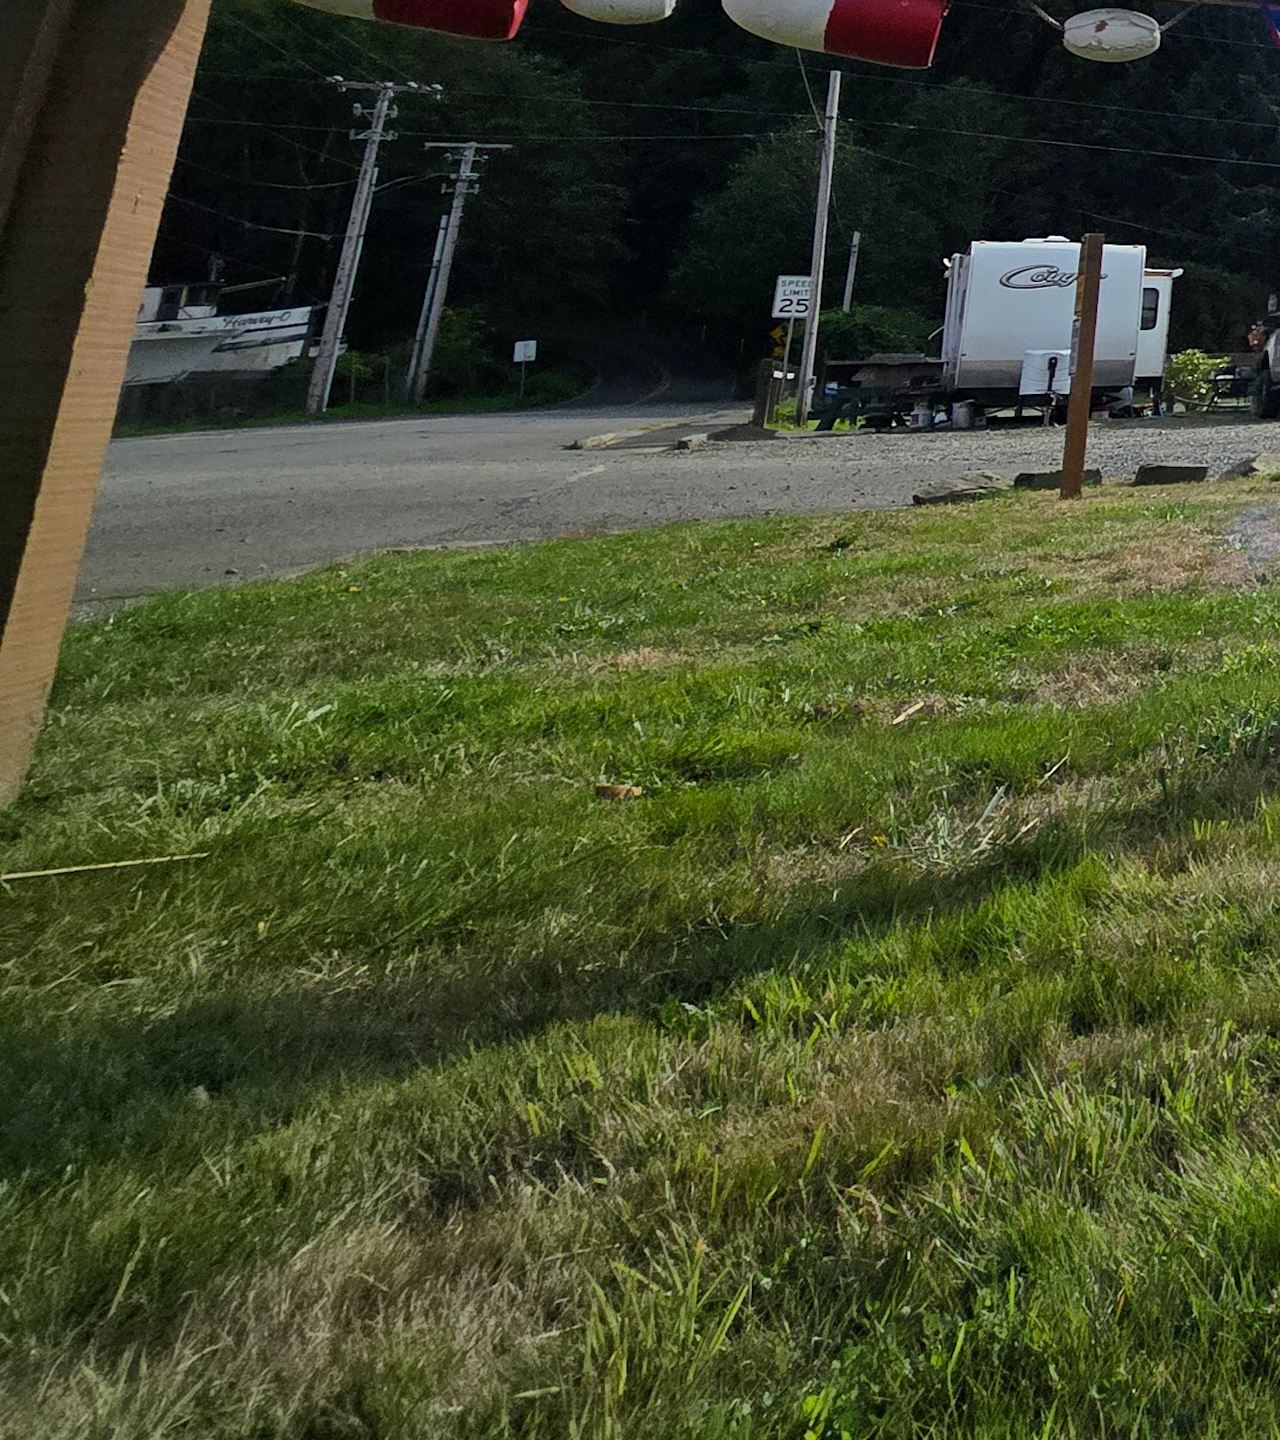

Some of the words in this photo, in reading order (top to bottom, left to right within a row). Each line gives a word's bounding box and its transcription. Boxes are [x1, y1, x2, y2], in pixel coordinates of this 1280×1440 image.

[999, 264, 1108, 289] Coug
[783, 289, 808, 297] LIMIT
[778, 298, 809, 313] 25
